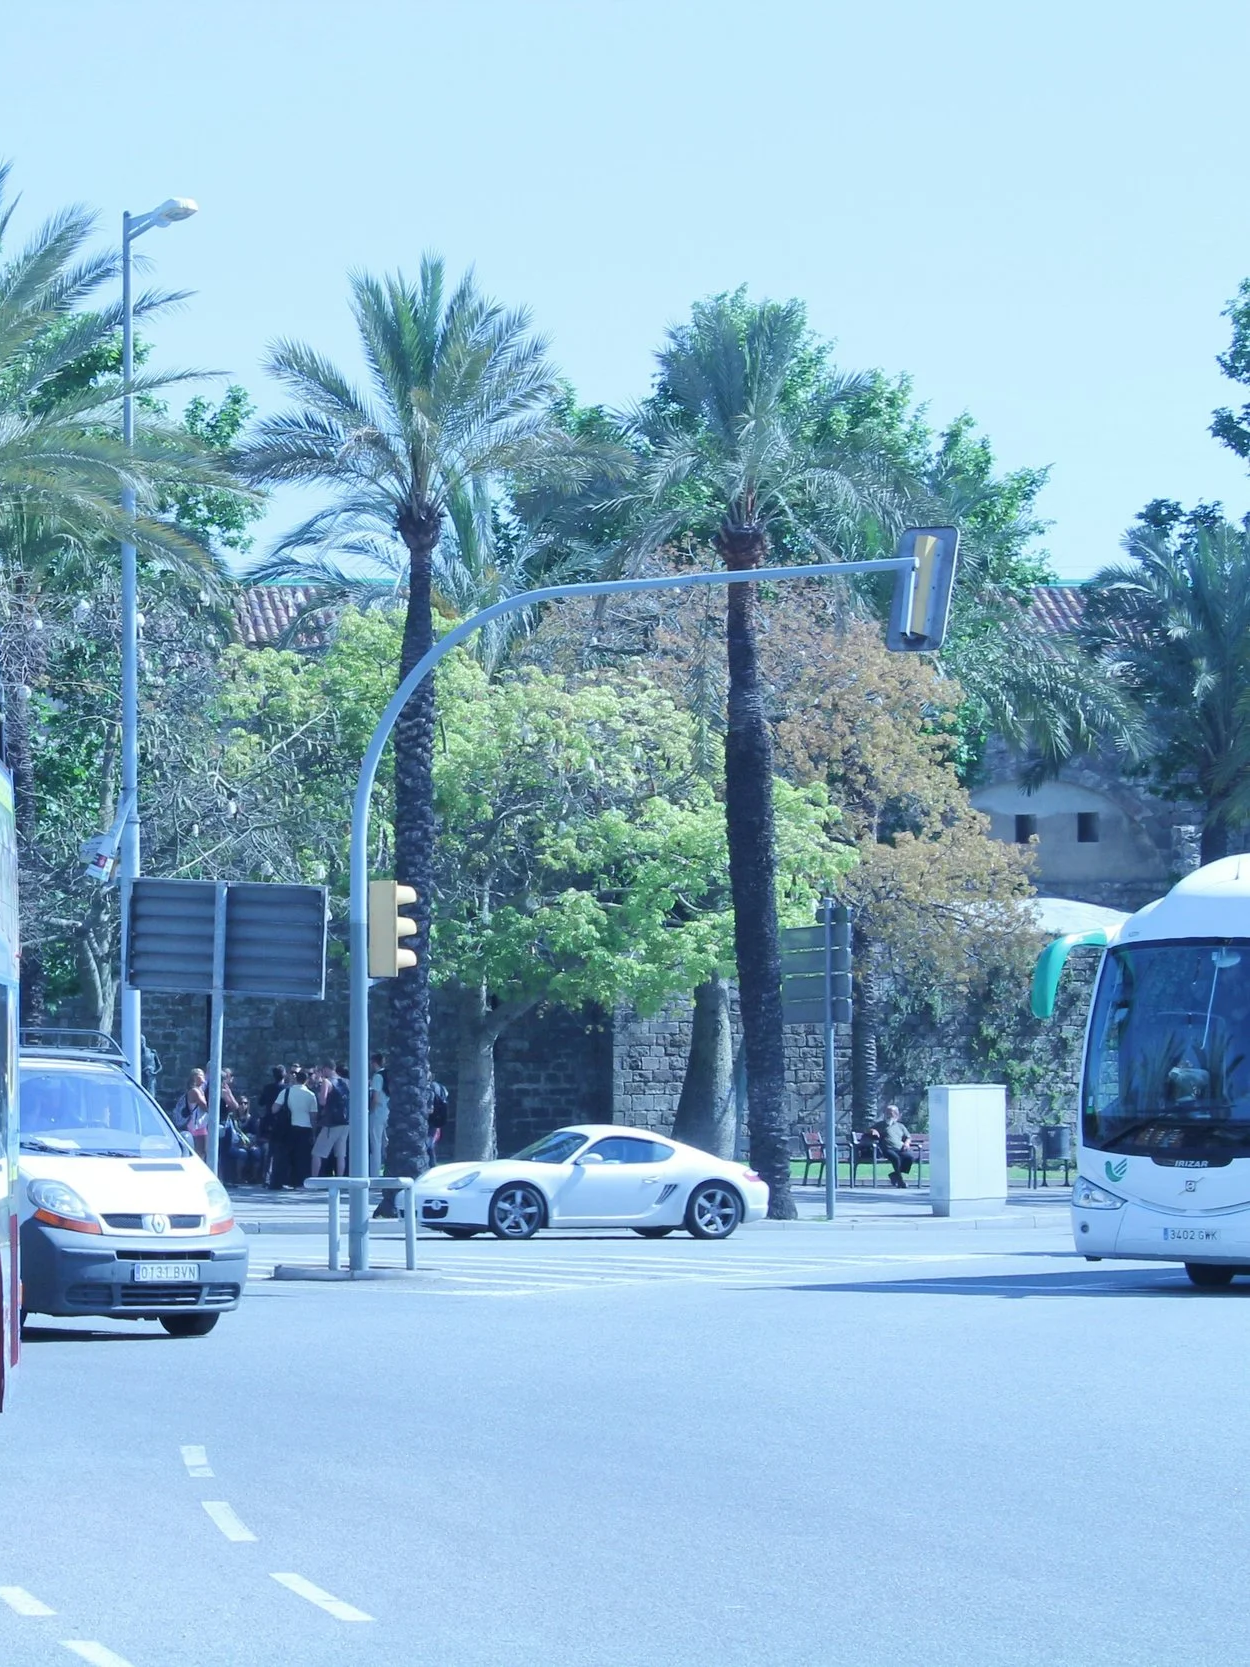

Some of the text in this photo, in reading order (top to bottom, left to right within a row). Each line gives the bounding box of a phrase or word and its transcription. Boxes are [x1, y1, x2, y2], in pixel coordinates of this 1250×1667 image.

[1174, 1160, 1209, 1168] IRIZAR
[1170, 1229, 1195, 1240] 3402
[174, 1266, 196, 1279] BVN
